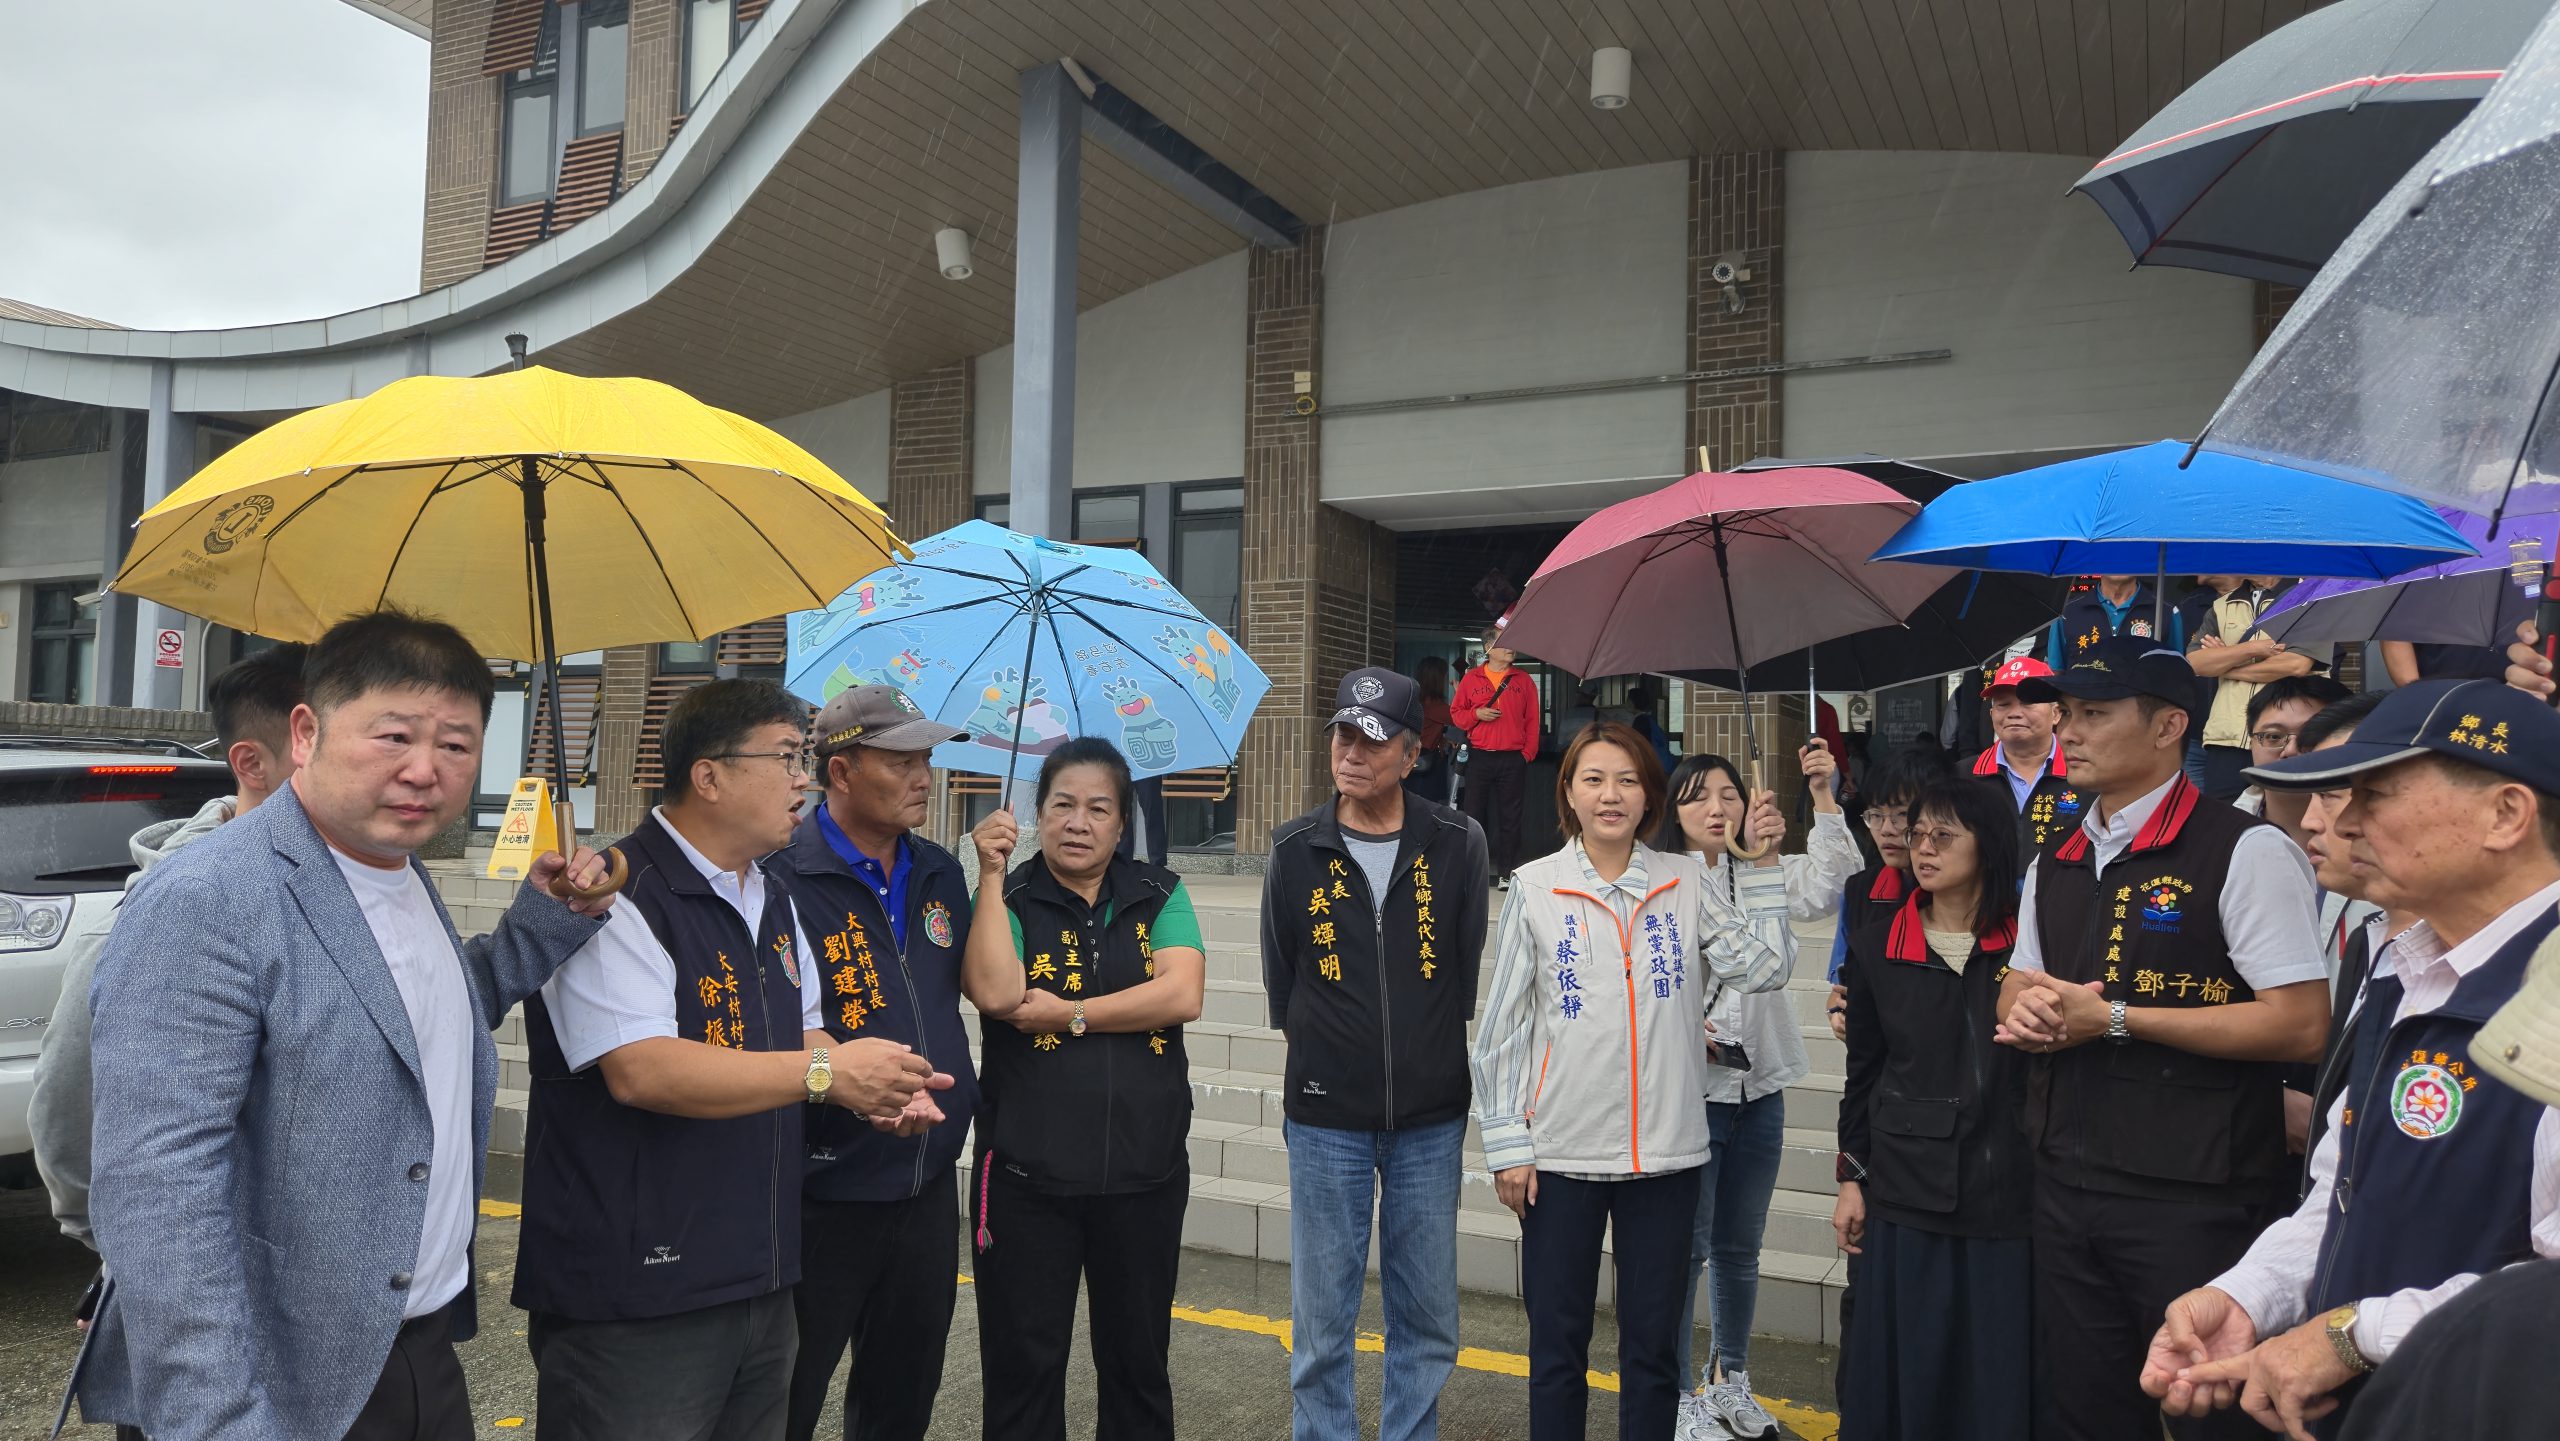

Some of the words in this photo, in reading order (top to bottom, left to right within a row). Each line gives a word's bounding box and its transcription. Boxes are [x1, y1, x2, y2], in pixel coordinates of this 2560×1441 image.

[2448, 729, 2508, 753] 林清水
[502, 835, 529, 844] 小心地滑
[1329, 858, 1351, 899] 代表
[1308, 887, 1342, 981] 吳輝明
[1413, 854, 1437, 979] 光復鄉民代表會
[1564, 914, 1577, 939] 議員
[1665, 912, 1684, 990] 花蓮縣議會
[2104, 886, 2132, 982] 建設處處長
[824, 931, 868, 1030] 劉建榮
[847, 911, 887, 1009] 大興村村長
[1061, 930, 1083, 992] 副主席
[1556, 939, 1583, 1020] 蔡依靜
[1644, 914, 1671, 999] 無黨政團
[2133, 969, 2235, 1004] 鄧子榆
